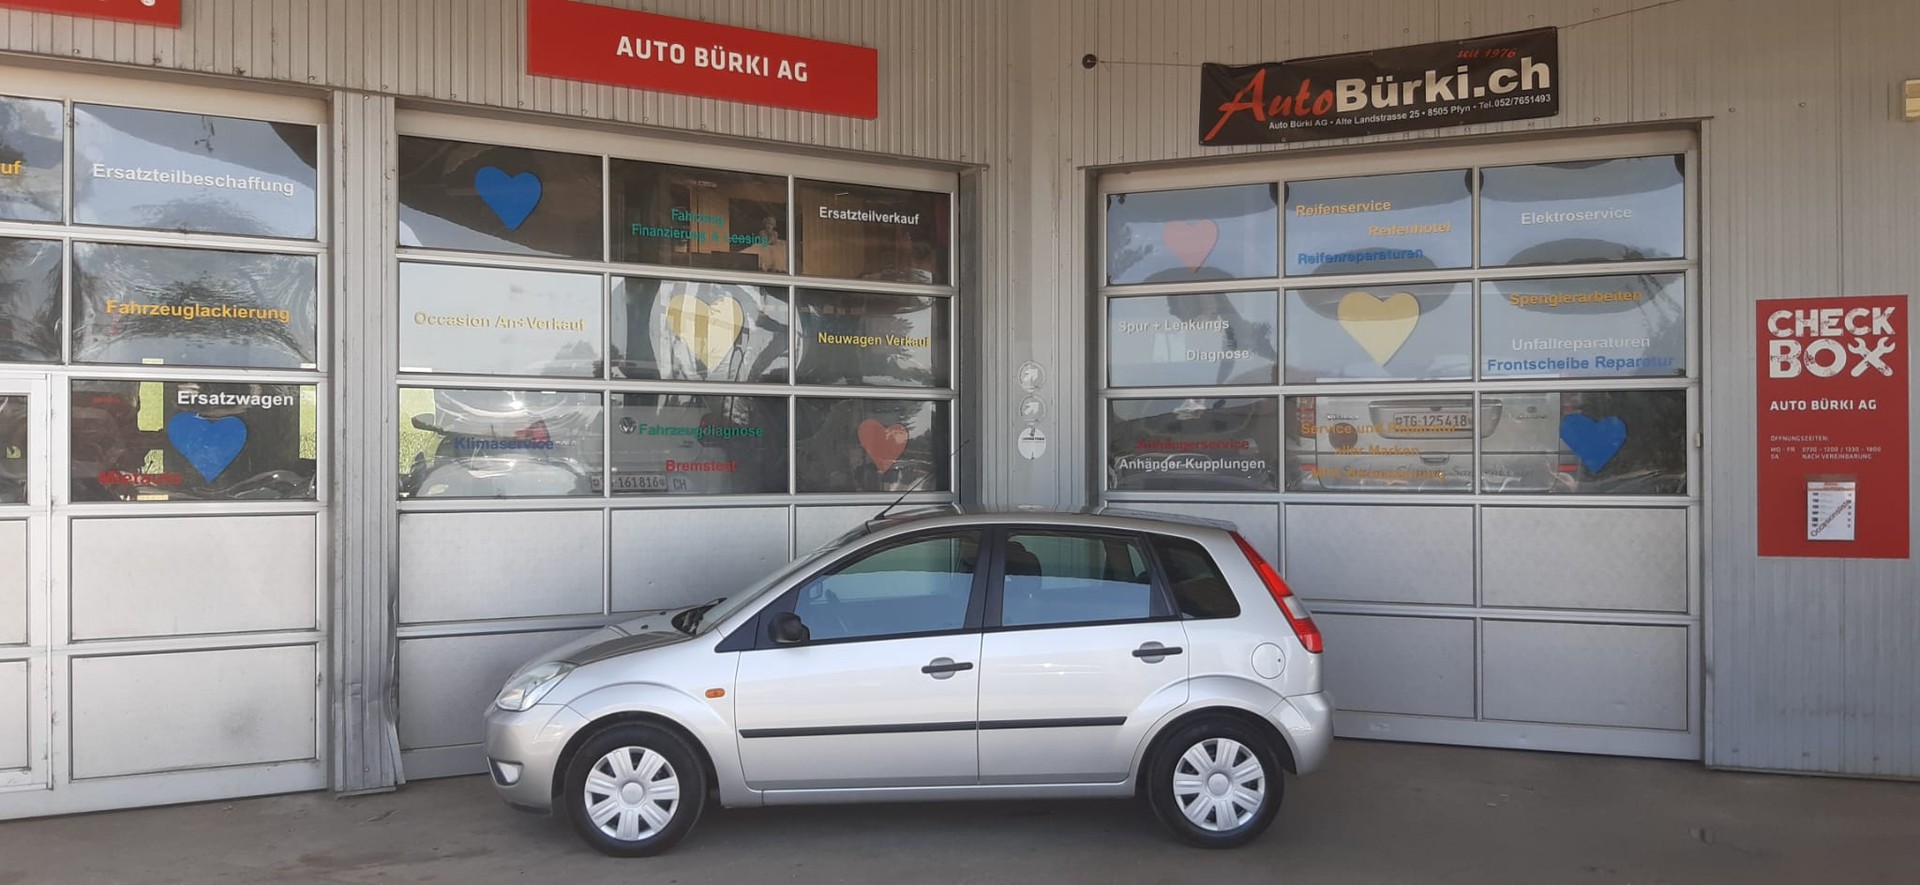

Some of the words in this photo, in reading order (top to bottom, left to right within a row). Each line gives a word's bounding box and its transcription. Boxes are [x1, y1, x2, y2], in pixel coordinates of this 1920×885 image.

[616, 36, 686, 65] AUTO
[694, 45, 769, 77] BÜRKI
[777, 60, 808, 82] AG
[1484, 48, 1517, 58] 1976
[1268, 121, 1288, 131] Auto
[1290, 119, 1312, 128] Bürki
[1315, 119, 1328, 127] AG
[1335, 118, 1353, 126] Alte
[1354, 113, 1407, 124] Landstrasse
[1409, 110, 1420, 119] 25
[1427, 106, 1449, 117] 8505
[1451, 104, 1471, 116] Pfyn
[92, 163, 295, 197] Ersatzteilbeschaffung
[819, 206, 920, 225] Ersatzteilverkauf
[1296, 200, 1392, 217] Reifenservice
[1521, 207, 1633, 225] Elektroservice
[631, 223, 707, 245] Finanzierung
[726, 233, 769, 248] Leasing
[1368, 221, 1452, 237] Reifenhotel
[1298, 249, 1424, 265] Reifenreparaturen
[1510, 289, 1644, 308] Spenglerarbeiten
[106, 300, 291, 324] Fahrzeuglackierung
[414, 311, 490, 328] Occasion
[1118, 321, 1149, 334] Spur
[1164, 318, 1230, 332] Lenkungs
[1767, 307, 1896, 337] CHECK
[818, 332, 882, 347] Neuwagen
[885, 334, 931, 347] Verkauf
[1512, 337, 1651, 352] Unfallreparaturen
[1186, 349, 1250, 362] Diagnose
[1487, 356, 1589, 371] Frontscheibe
[1595, 355, 1675, 372] Reparatur
[1769, 337, 1896, 378] BOX
[177, 390, 294, 409] Ersatzwagen
[1769, 400, 1807, 411] AUTO
[1811, 397, 1854, 411] BÜRKI
[1858, 399, 1877, 410] AG
[639, 423, 764, 439] Fahrzeugdiagnose
[1301, 422, 1351, 434] Service
[454, 436, 554, 450] Klimaservice
[665, 459, 737, 473] Bremstest
[672, 478, 687, 491] CH
